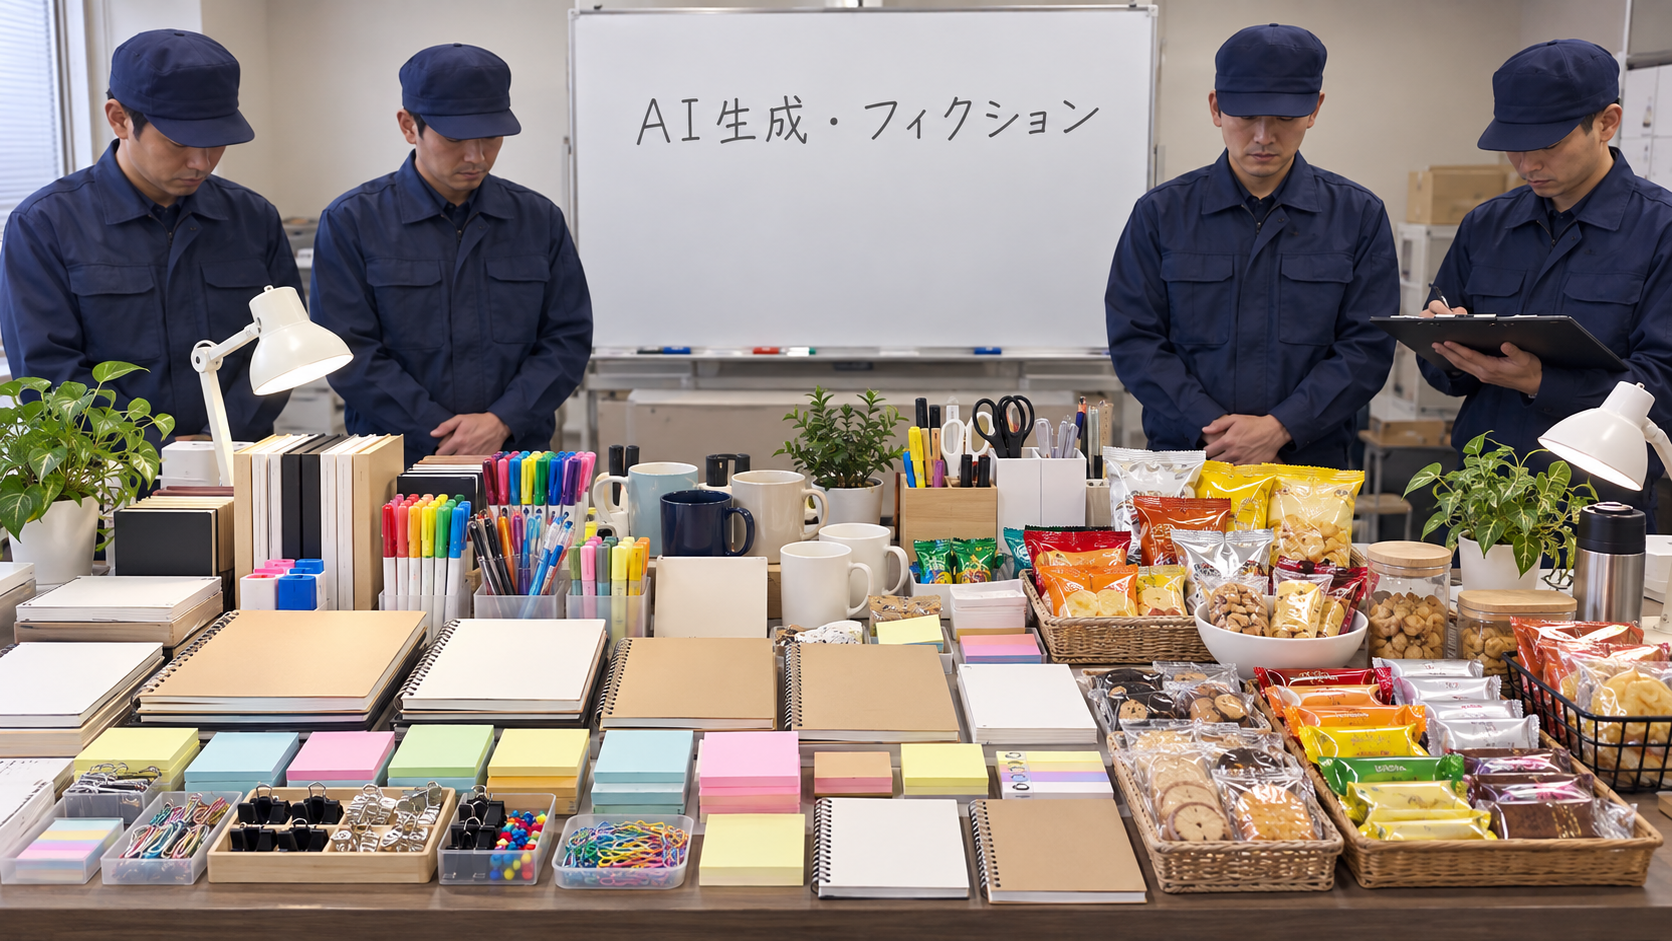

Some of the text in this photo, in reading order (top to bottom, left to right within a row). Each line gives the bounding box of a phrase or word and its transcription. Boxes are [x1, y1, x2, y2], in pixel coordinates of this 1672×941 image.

[636, 94, 1099, 145] AI生成・フィクション
